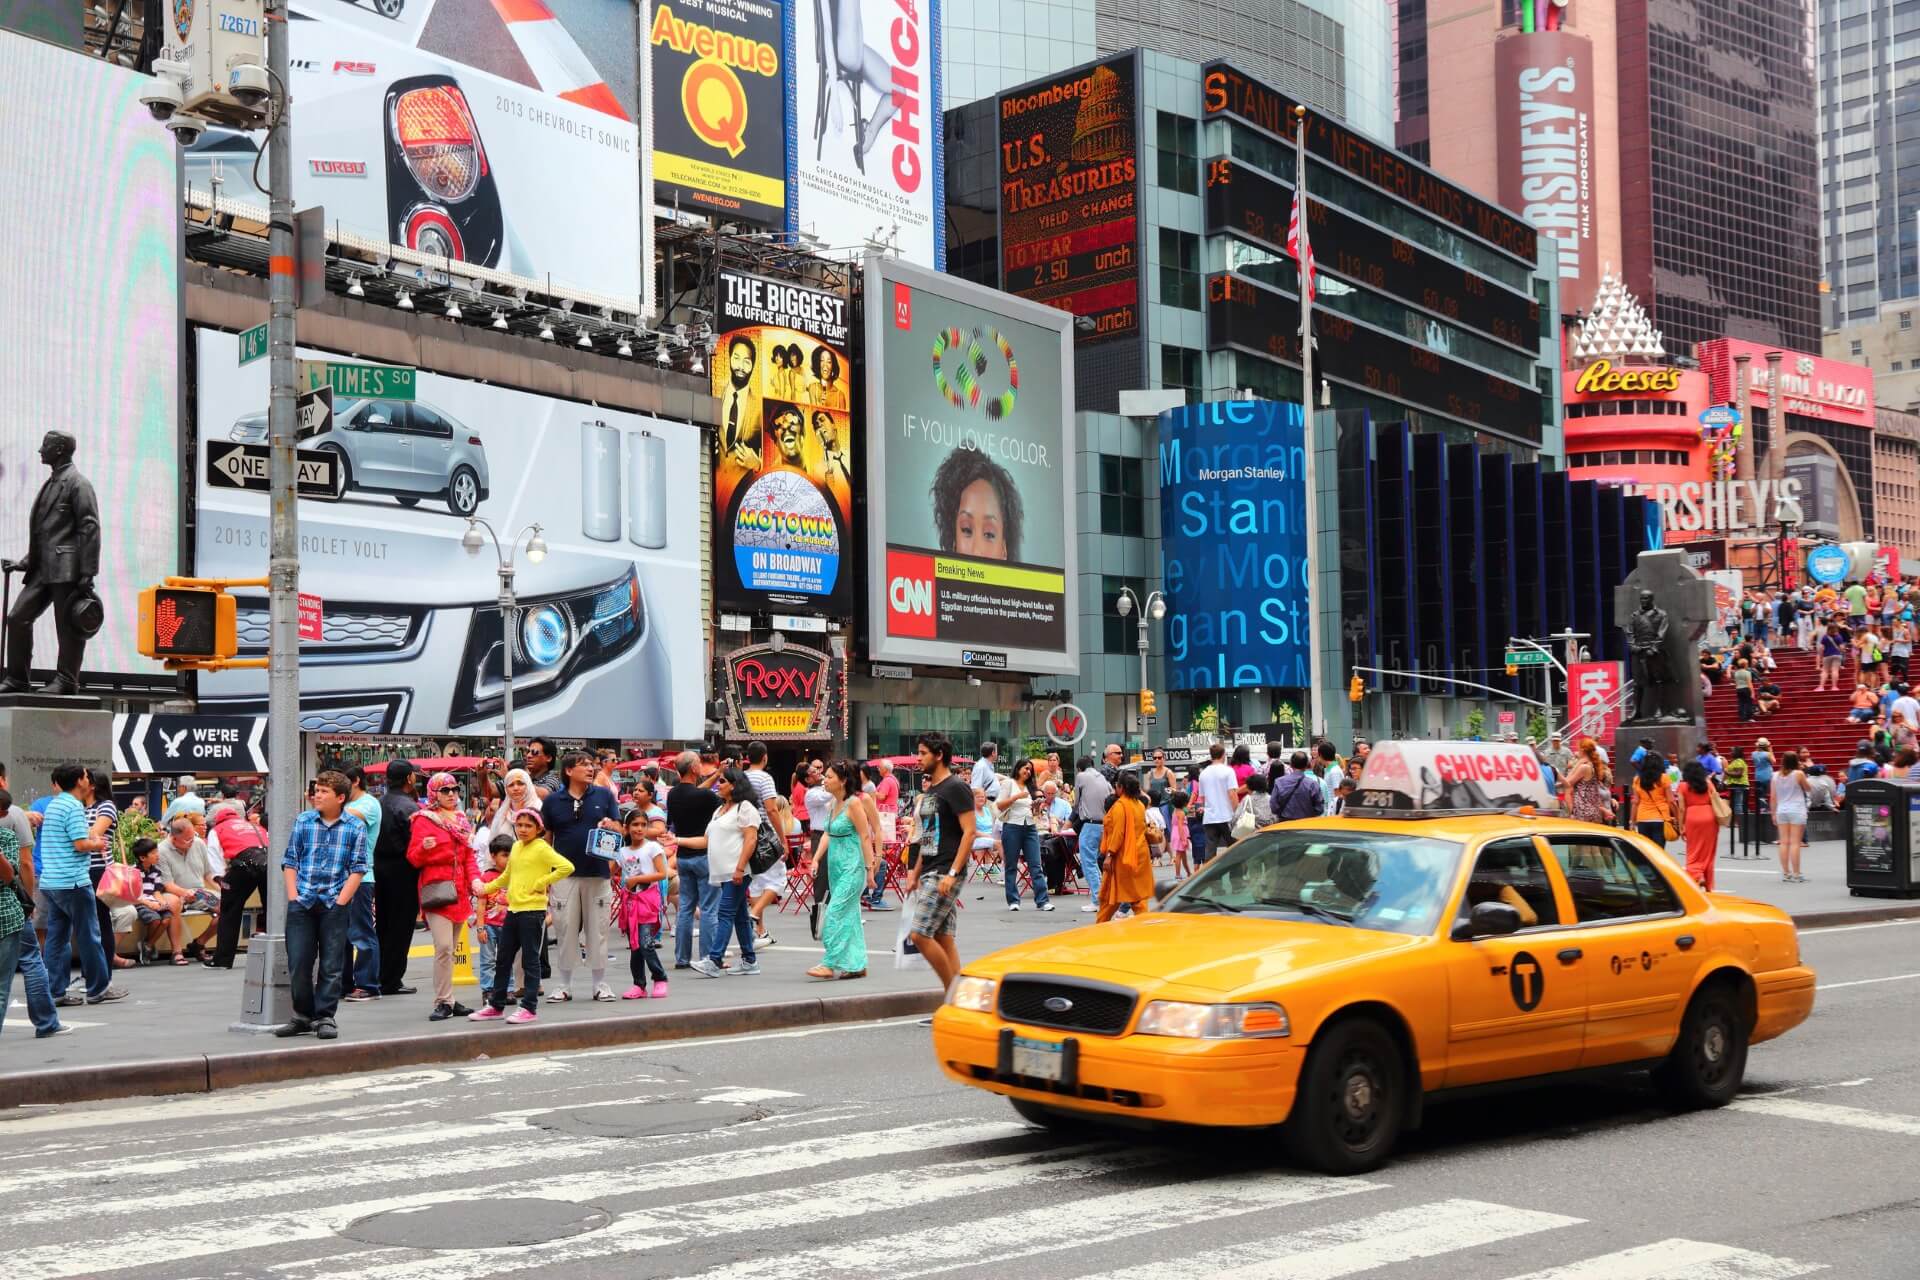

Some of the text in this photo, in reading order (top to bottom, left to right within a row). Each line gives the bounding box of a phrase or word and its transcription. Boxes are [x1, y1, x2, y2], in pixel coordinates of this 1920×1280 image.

[219, 13, 258, 36] 72671
[706, 2, 747, 22] MUSICAL
[651, 4, 777, 76] Avenue
[681, 58, 746, 159] Q
[1003, 77, 1093, 119] Bloomberg
[496, 95, 631, 153] 2013 CHEVROLET SONIC
[1003, 132, 1052, 174] U.S.
[1205, 72, 1312, 146] STANLEY
[1331, 128, 1463, 226] NETHERLANDS
[309, 159, 367, 175] TURBO
[1578, 111, 1591, 239] MILK CHOCOLATE
[1003, 157, 1136, 213] TREASURIES
[1039, 192, 1134, 230] YIELD CHANGE
[1094, 244, 1131, 271] unch
[725, 302, 743, 318] BOX
[744, 306, 774, 325] OFFICE
[775, 313, 790, 328] HIT
[791, 315, 803, 331] OF
[804, 319, 820, 334] THE
[767, 284, 844, 325] BIGGEST
[259, 327, 266, 341] ST
[1096, 306, 1133, 333] unch
[327, 366, 411, 395] TIMES SQ
[1575, 358, 1683, 394] Reese's
[903, 413, 1051, 468] IF YOU LOVE COLOR.
[228, 456, 322, 481] ONE AY
[1199, 466, 1286, 482] Morgan Stanley
[1624, 477, 1804, 533] RSHEY'S
[737, 506, 833, 539] MOTOWN
[215, 526, 389, 559] 2013 CROLET VOLT
[752, 551, 822, 574] ON BROADWAY
[937, 562, 985, 579] Breaking News
[299, 597, 320, 610] STANDING
[890, 576, 932, 616] CNN
[193, 728, 239, 742] WE'RE
[750, 715, 807, 727] DELICATESSEN
[1051, 714, 1080, 736] W
[193, 745, 233, 757] OPEN
[1170, 750, 1189, 760] DOGS
[1435, 754, 1539, 782] CHICAGO
